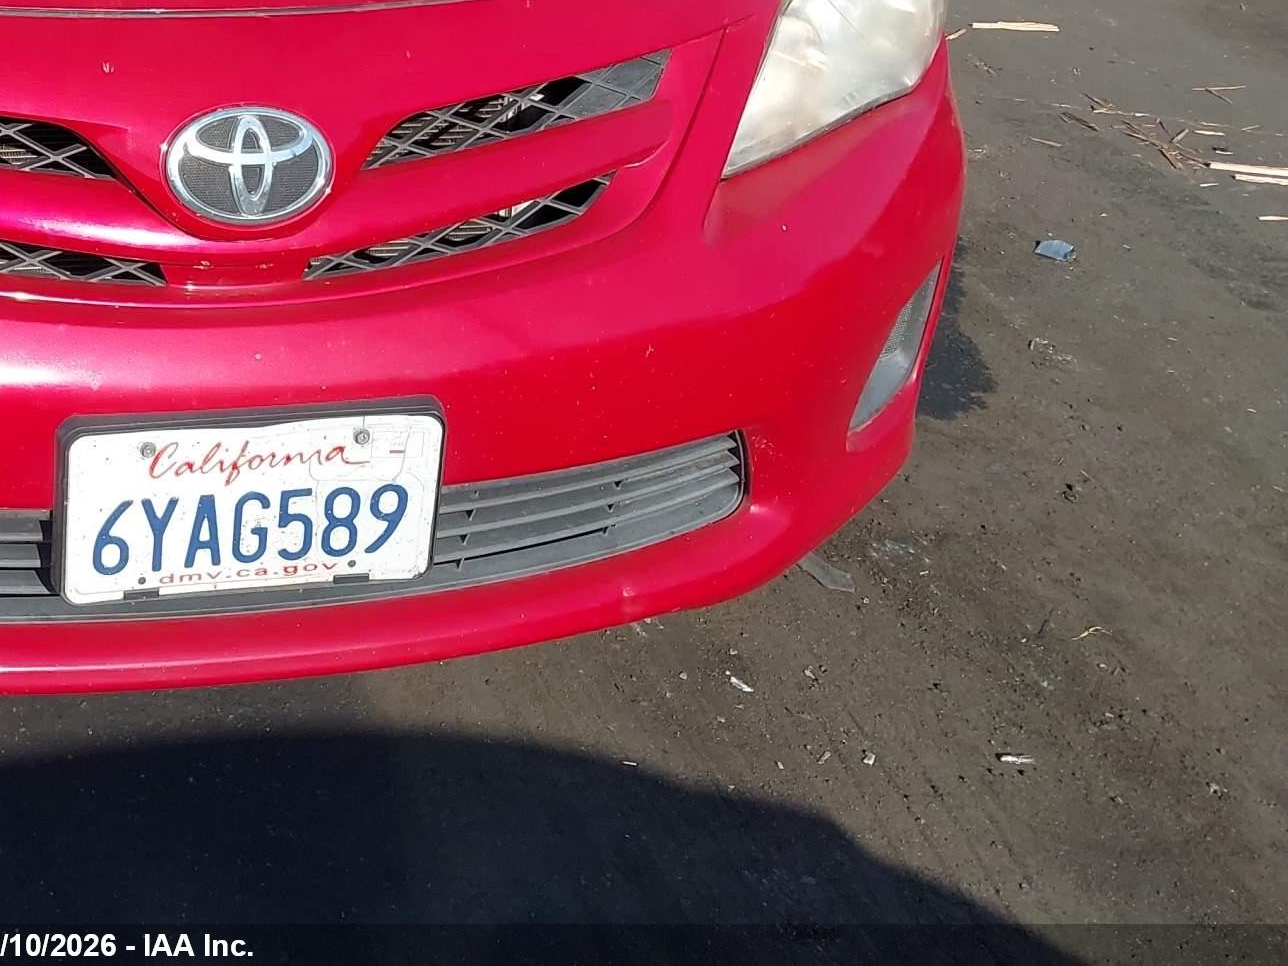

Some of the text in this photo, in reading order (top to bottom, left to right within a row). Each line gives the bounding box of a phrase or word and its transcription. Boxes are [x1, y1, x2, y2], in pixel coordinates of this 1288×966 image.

[148, 440, 370, 486] California
[91, 483, 409, 576] 6YAG589
[159, 561, 340, 585] dmv.ca.gov
